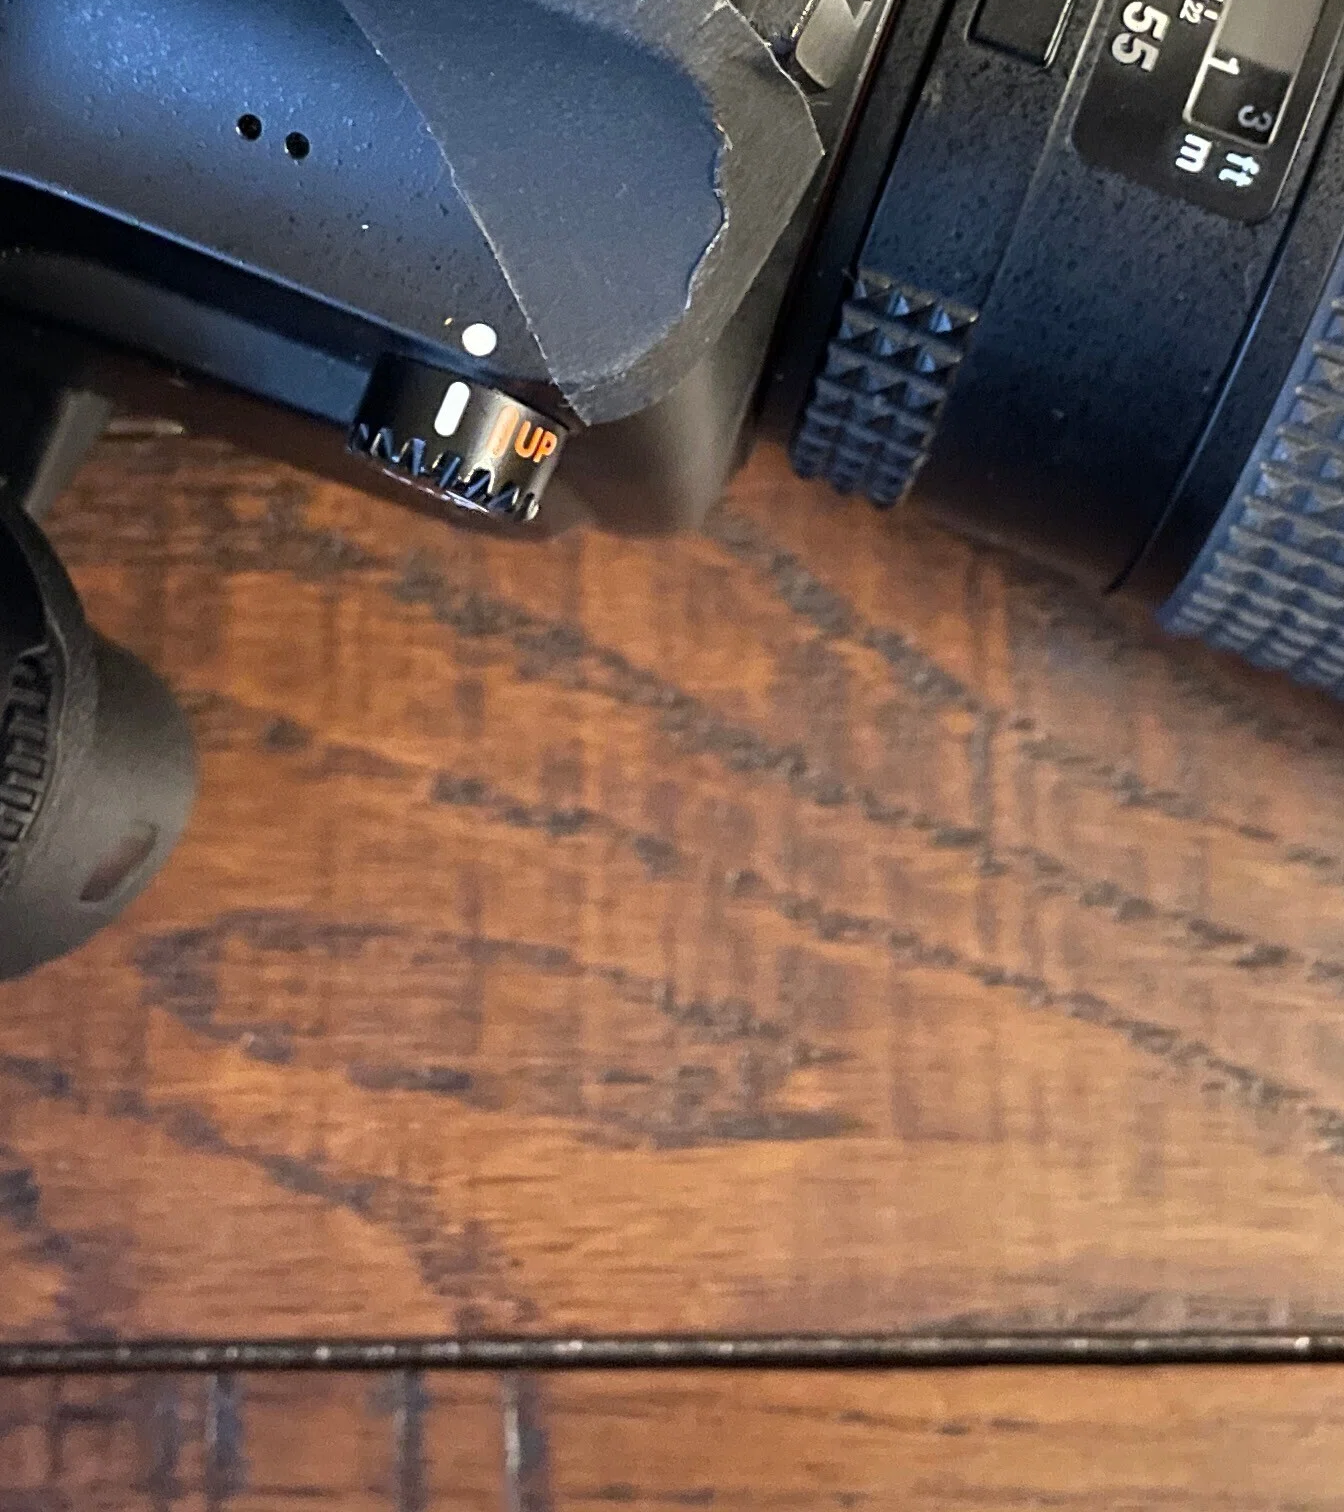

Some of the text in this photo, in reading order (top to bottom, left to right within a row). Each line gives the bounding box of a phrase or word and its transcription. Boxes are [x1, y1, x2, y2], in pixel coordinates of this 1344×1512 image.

[1202, 52, 1241, 80] 1
[1236, 103, 1274, 136] 3
[1174, 133, 1213, 175] m
[1216, 149, 1262, 189] ft
[513, 419, 559, 463] UP
